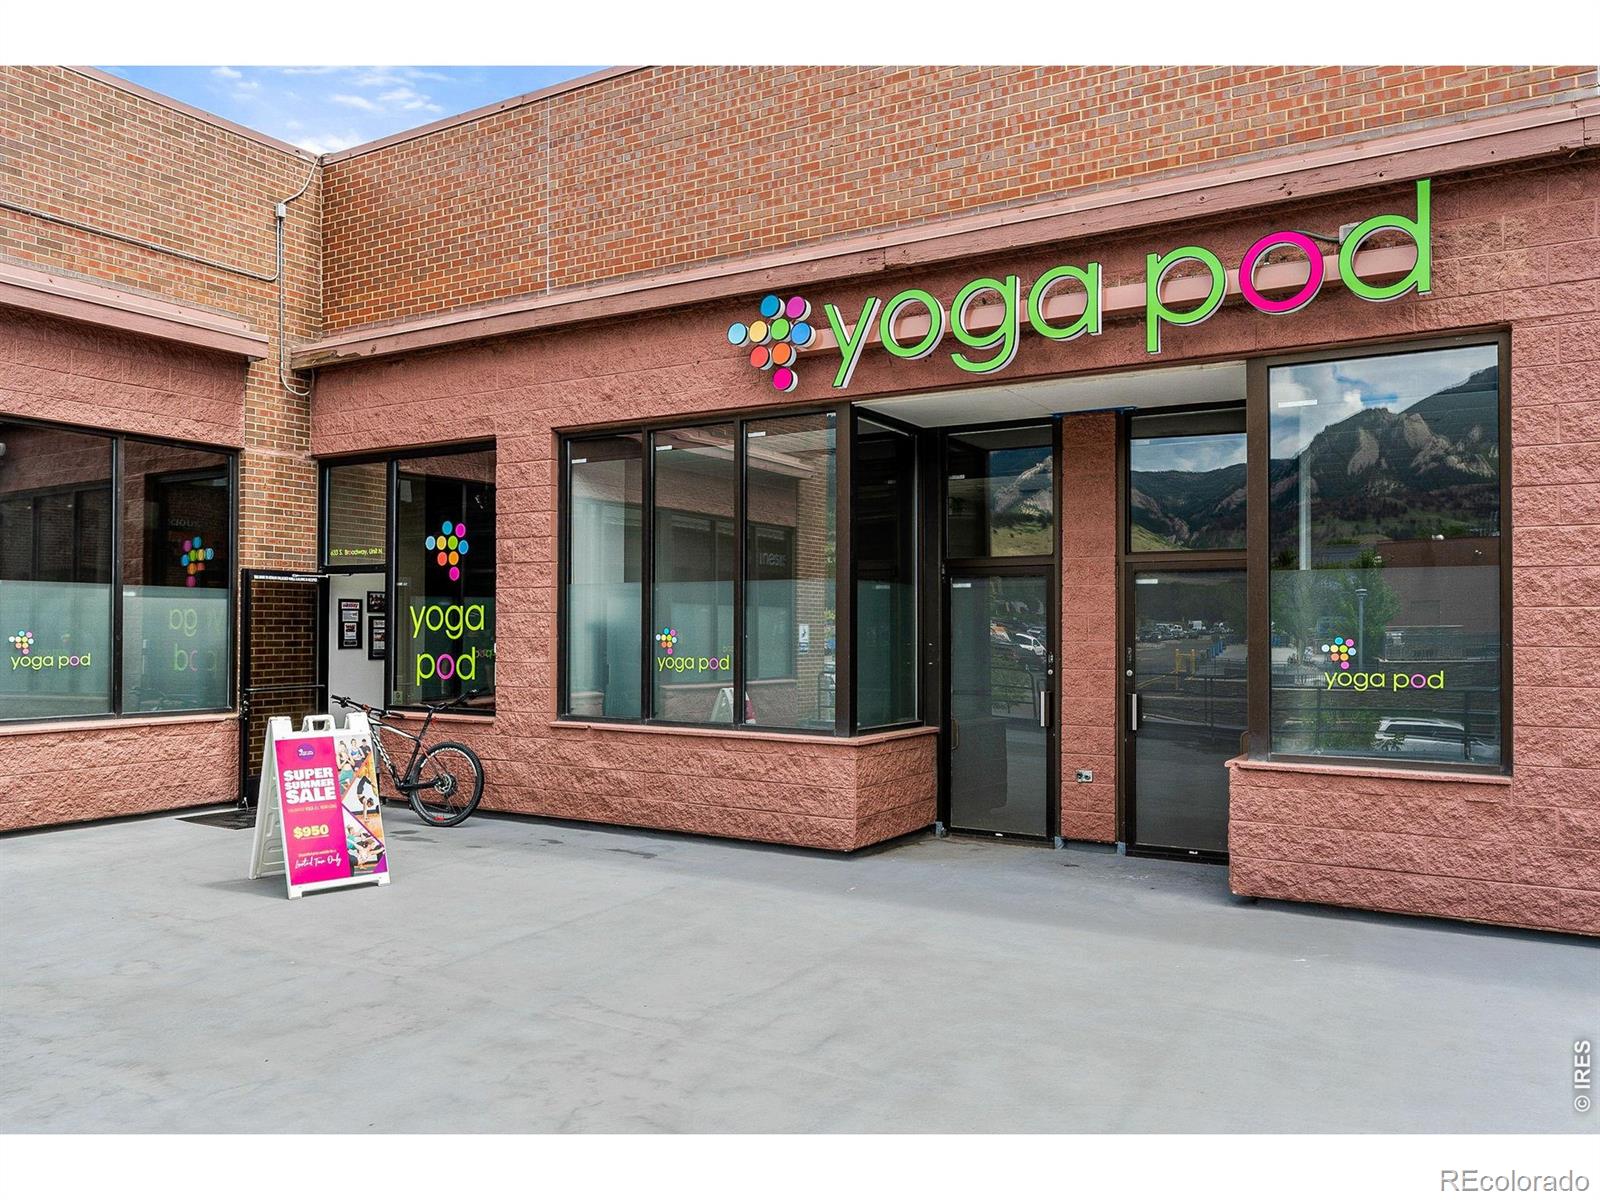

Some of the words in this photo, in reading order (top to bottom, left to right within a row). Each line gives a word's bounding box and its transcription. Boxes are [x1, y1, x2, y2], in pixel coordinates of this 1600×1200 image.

[824, 261, 1102, 389] yoga
[1146, 177, 1432, 354] pod
[409, 604, 485, 640] yoga
[10, 655, 54, 670] yoga
[58, 652, 91, 669] pod
[417, 646, 476, 687] pod
[657, 656, 695, 673] yoga
[698, 654, 730, 673] pod
[1324, 672, 1385, 692] yoga
[1393, 670, 1444, 692] pod
[283, 767, 334, 783] SUPER
[284, 778, 335, 791] SUMMER
[285, 786, 337, 804] SALE
[293, 824, 330, 840] $950
